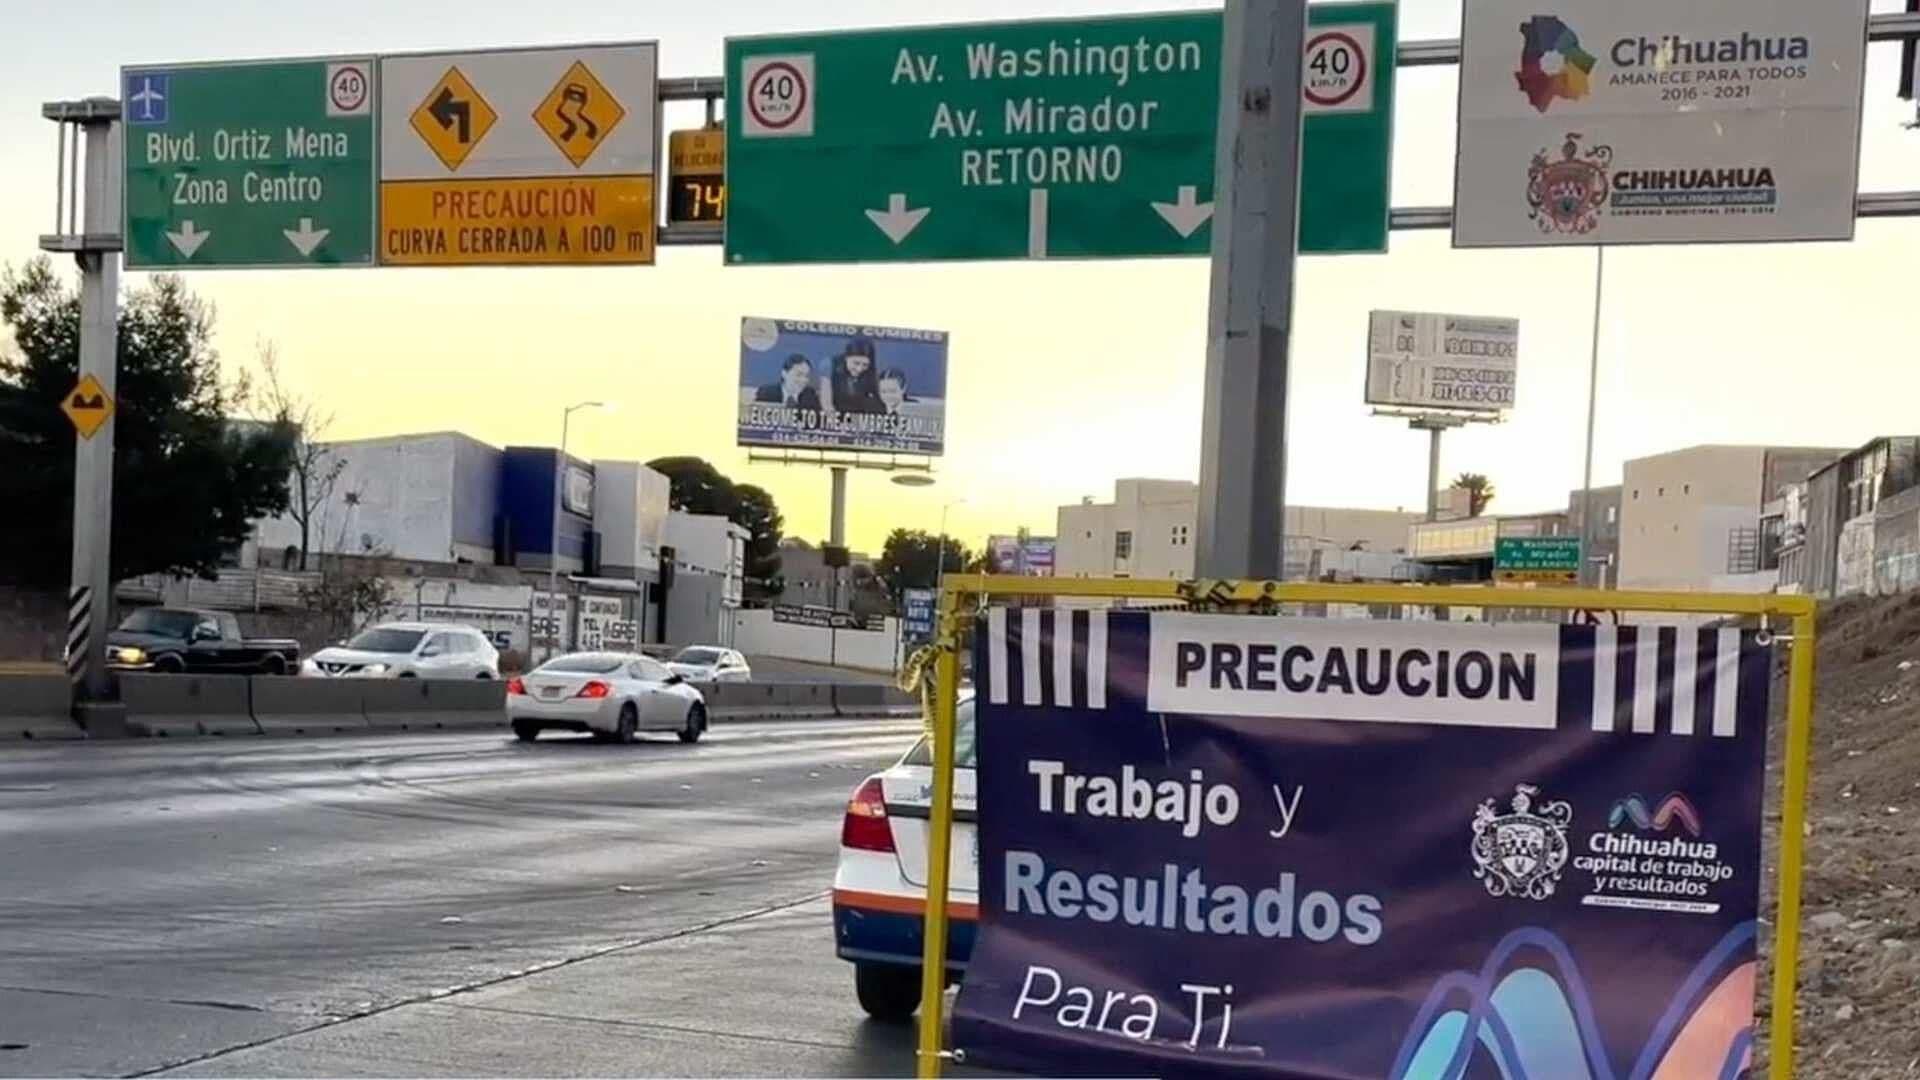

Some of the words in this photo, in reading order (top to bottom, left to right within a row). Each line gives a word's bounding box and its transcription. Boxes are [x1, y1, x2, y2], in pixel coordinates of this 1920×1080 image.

[891, 49, 943, 85] Av.
[966, 36, 1201, 87] Washington
[1310, 48, 1349, 75] 40
[1611, 32, 1809, 68] Chihuahua
[339, 78, 358, 93] 40
[759, 77, 793, 100] 40
[1310, 75, 1347, 90] km/h
[1609, 71, 1691, 85] AMANECE
[1697, 69, 1742, 83] PARA
[1747, 66, 1806, 80] TODOS
[1661, 87, 1697, 100] 2016
[1715, 85, 1750, 99] 2021
[760, 101, 791, 113] km/h
[929, 103, 983, 139] Av.
[1003, 96, 1157, 134] Mirador
[147, 132, 200, 163] Blvd.
[214, 129, 270, 161] Ortiz
[286, 130, 347, 159] Mena
[962, 145, 1122, 185] RETORNO
[1612, 167, 1775, 190] CHIHUAHUA
[174, 173, 228, 204] Zona
[244, 173, 321, 202] Centro
[686, 183, 725, 217] 74
[388, 227, 446, 253] CURVA
[458, 226, 545, 253] CERRADA
[557, 226, 570, 252] A
[583, 225, 616, 252] 100
[627, 231, 644, 252] m
[784, 320, 857, 336] COLEGIO
[862, 325, 942, 342] CUMBRES
[740, 405, 798, 426] WELCOME
[801, 409, 817, 428] TO
[819, 410, 841, 430] THE
[1175, 641, 1537, 703] PRECAUCION
[1028, 759, 1240, 837] Trabajo
[1270, 784, 1304, 839] y
[1589, 832, 1718, 859] Chihuahua
[1573, 853, 1636, 873] capital
[1639, 856, 1664, 874] de
[1667, 860, 1733, 882] trabajo
[1005, 851, 1383, 945] Resultados
[1593, 877, 1607, 893] y
[1609, 876, 1708, 896] resultados
[1012, 965, 1159, 1041] Para
[1179, 984, 1233, 1051] Ti
